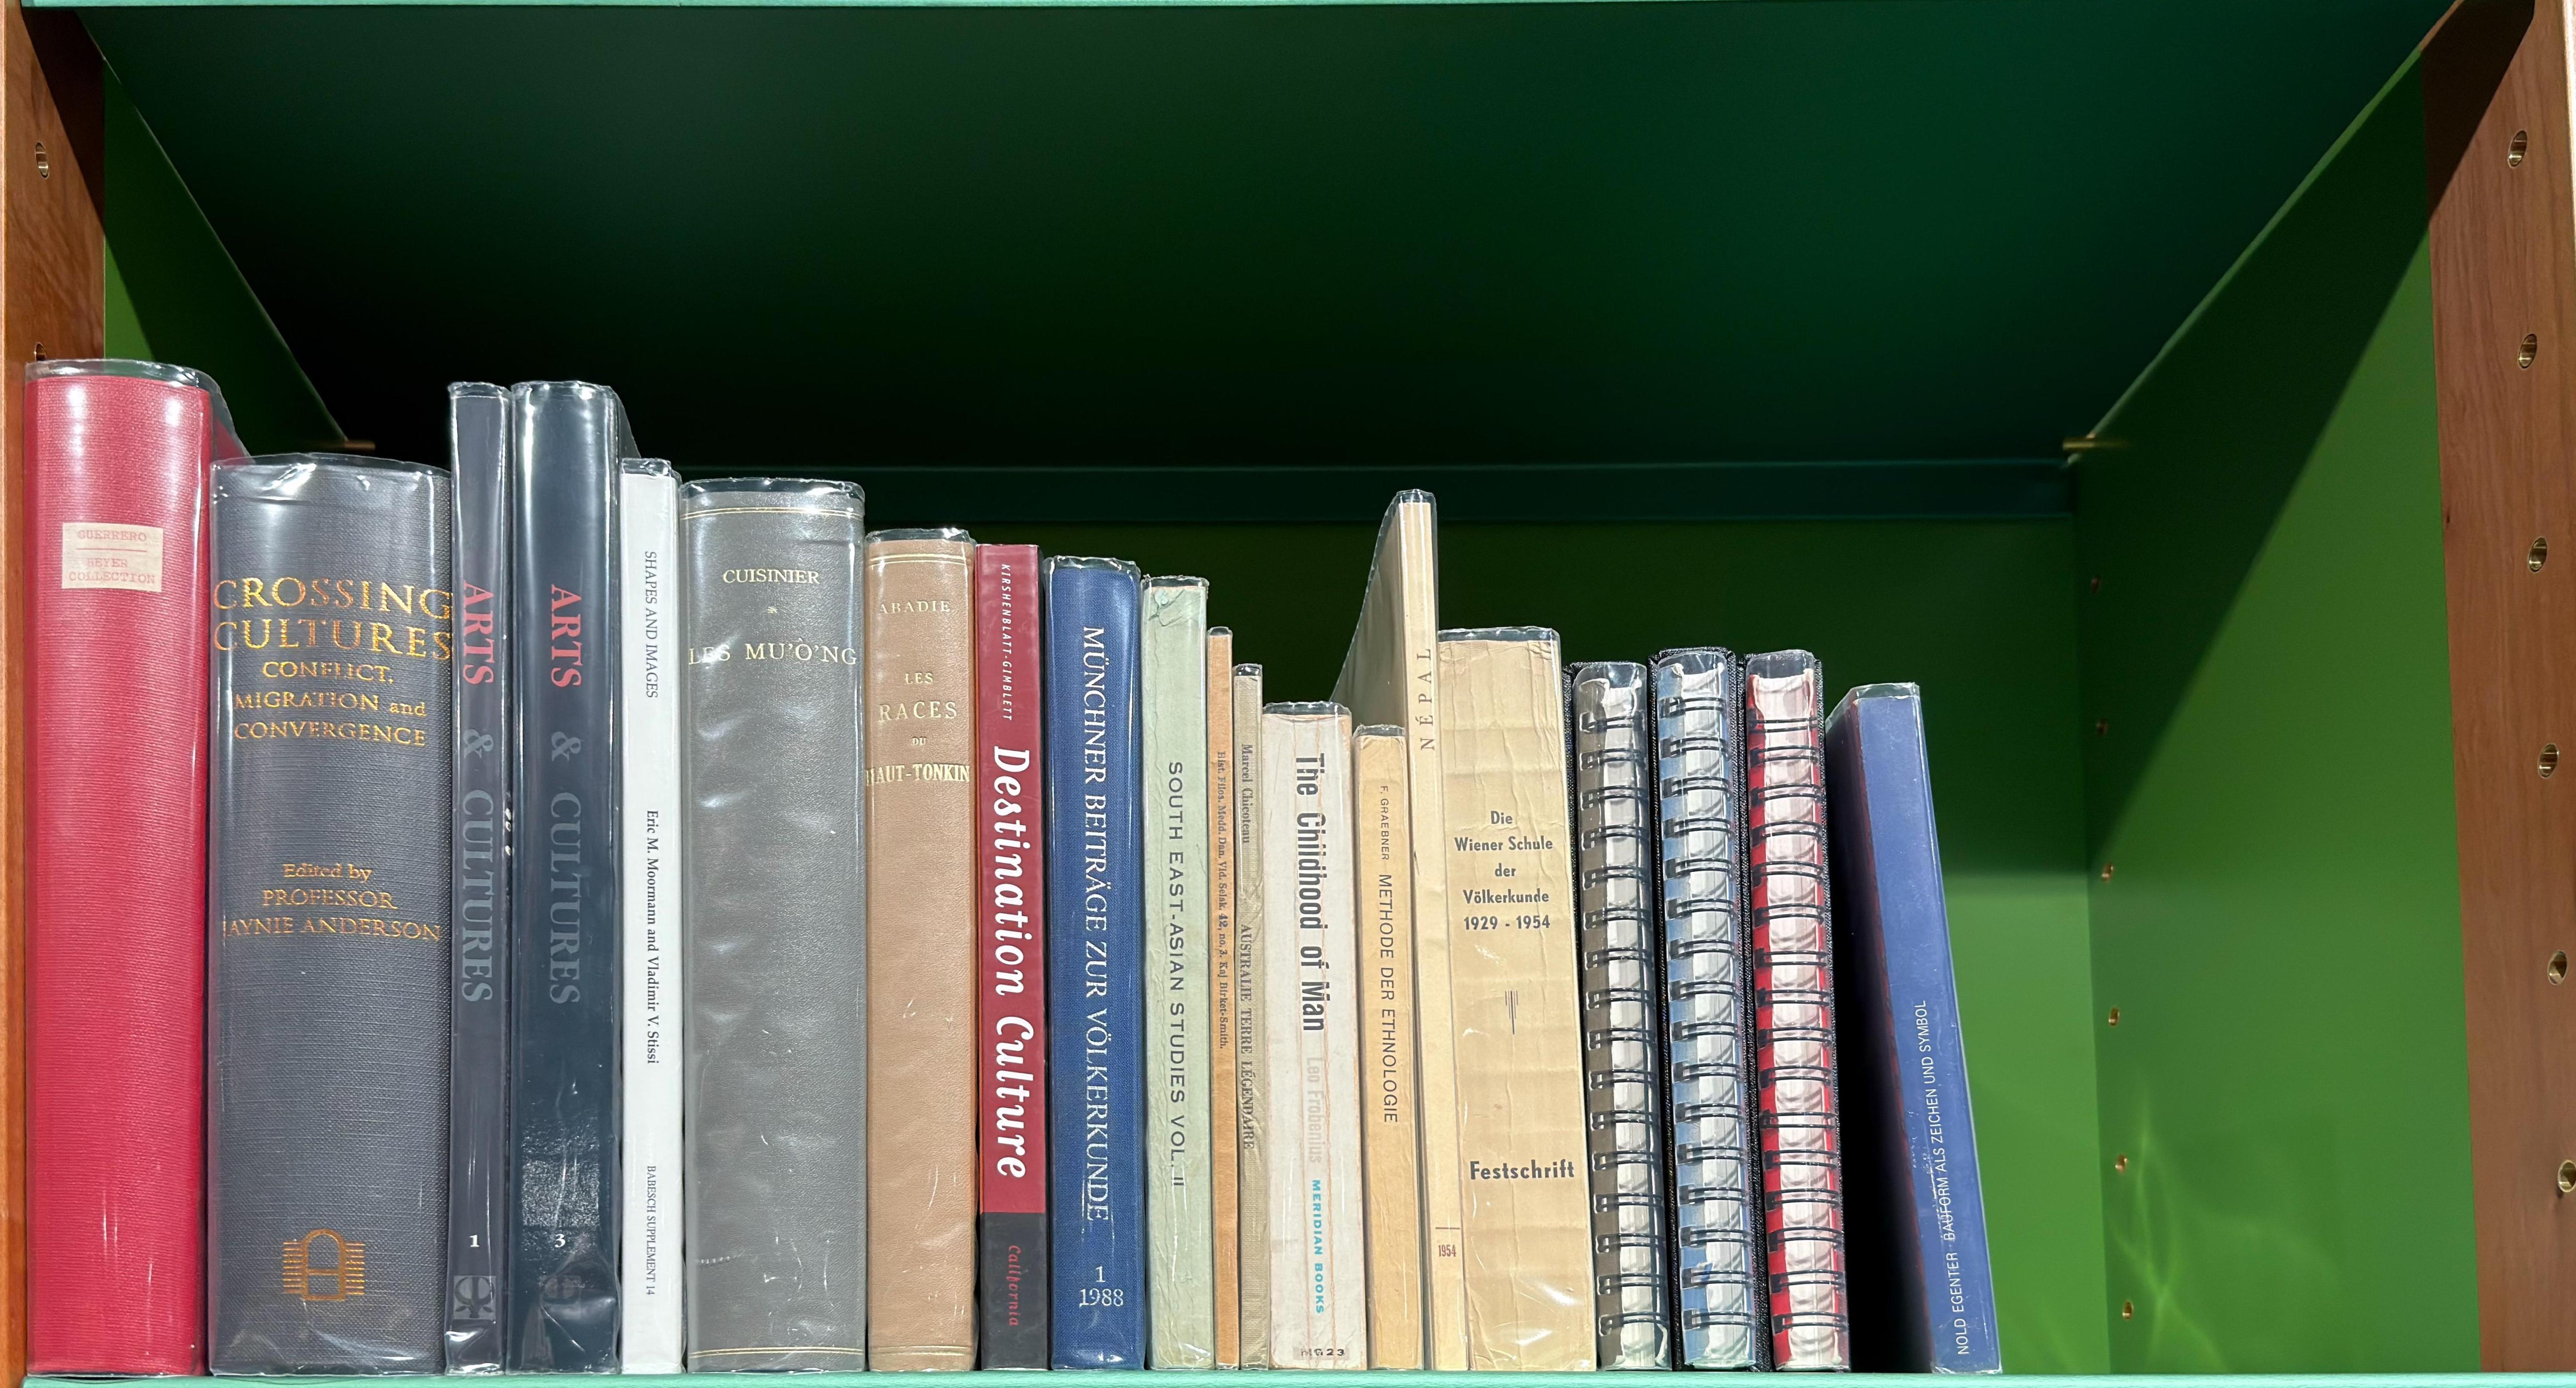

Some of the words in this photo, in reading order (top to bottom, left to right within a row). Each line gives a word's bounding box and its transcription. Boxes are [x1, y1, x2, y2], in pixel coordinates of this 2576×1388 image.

[69, 572, 155, 584] COLLECTION
[645, 551, 657, 604] SHAPES
[723, 569, 820, 584] CUISINIER
[213, 577, 452, 619] CROSSING
[880, 601, 950, 614] ABADIE
[214, 619, 451, 660] CULTURES
[463, 580, 495, 685] ARTS
[551, 584, 583, 687] ARTS
[645, 608, 657, 639] AND
[1001, 564, 1012, 721] KIRSHENBLATT-GIMBLETT
[646, 644, 658, 698] IMAGES
[688, 644, 731, 665] LES
[905, 672, 933, 684] LES
[234, 691, 379, 710] MIGRATION
[389, 702, 427, 716] and
[879, 701, 957, 721] RACES
[1083, 626, 1109, 784] MÜNCHNER
[1415, 649, 1435, 750] NÉPAL
[234, 721, 427, 746] CONVERGENCE
[463, 729, 494, 758] &
[551, 731, 581, 762] &
[912, 737, 926, 746] DU
[1242, 743, 1253, 782] Marcel
[1296, 753, 1325, 795] The
[1169, 762, 1183, 840] SOUTH
[1491, 811, 1513, 825] Die
[647, 811, 658, 833] Eric
[1381, 799, 1389, 860] GRAEBNER
[647, 838, 658, 853] M.
[1085, 794, 1112, 931] BEITRÄGE
[1218, 838, 1227, 859] Dan.
[1454, 836, 1503, 851] Wiener
[1508, 835, 1553, 851] Schule
[282, 863, 343, 878] Edited
[348, 863, 373, 883] by
[994, 746, 1032, 996] Destination
[1297, 813, 1328, 928] Childhood
[1495, 863, 1516, 877] der
[262, 889, 399, 909] PROFESSOR
[462, 790, 494, 1002] CULTURES
[550, 792, 581, 1004] CULTURES
[647, 859, 658, 924] Moormann
[1463, 888, 1549, 904] Völkerkunde
[301, 917, 440, 942] ANDERSON
[1169, 851, 1184, 991] EAST-ASIAN
[1379, 875, 1394, 958] METHODE
[1464, 916, 1498, 930] 1929
[1516, 915, 1550, 929] 1954
[648, 929, 659, 951] and
[1300, 945, 1330, 969] of
[1086, 940, 1107, 998] ZUR
[1240, 924, 1252, 1001] AUSTRALIE
[648, 956, 659, 1011] Vladimir
[1381, 968, 1394, 1000] DER
[648, 1015, 659, 1026] V.
[1301, 981, 1330, 1031] Man
[1915, 1000, 1931, 1052] SYMBOL
[648, 1031, 659, 1064] Stissi
[1240, 1008, 1252, 1054] TERRE
[1170, 1003, 1184, 1103] STUDIES
[1307, 1057, 1323, 1083] Leo
[1382, 1009, 1397, 1122] ETHNOLOGIE
[1922, 1056, 1935, 1084] UND
[995, 1017, 1034, 1179] Culture
[1086, 1009, 1112, 1221] VÖLKERKUNDE
[1241, 1061, 1256, 1149] LÉGENDAIRE
[1926, 1089, 1943, 1144] ZEICHEN
[1171, 1115, 1185, 1167] VOL.
[1308, 1090, 1325, 1163] Frobenius
[1470, 1159, 1574, 1180] Festschrift
[1933, 1148, 1947, 1172] ALS
[647, 1166, 656, 1213] BABESCH
[1936, 1177, 1956, 1241] BAUFORM
[1312, 1180, 1323, 1255] MERIDIAN
[469, 1234, 479, 1247] 1
[555, 1234, 566, 1247] 3
[647, 1215, 656, 1282] SUPPLEMENT
[1438, 1244, 1457, 1257] 1954
[647, 1286, 655, 1295] 14
[1006, 1246, 1022, 1326] California
[1095, 1266, 1106, 1283] 1
[1315, 1263, 1324, 1314] BOOKS
[1946, 1252, 1964, 1312] EGENTER
[1079, 1288, 1123, 1308] 1988
[1954, 1318, 1969, 1355] NOLD
